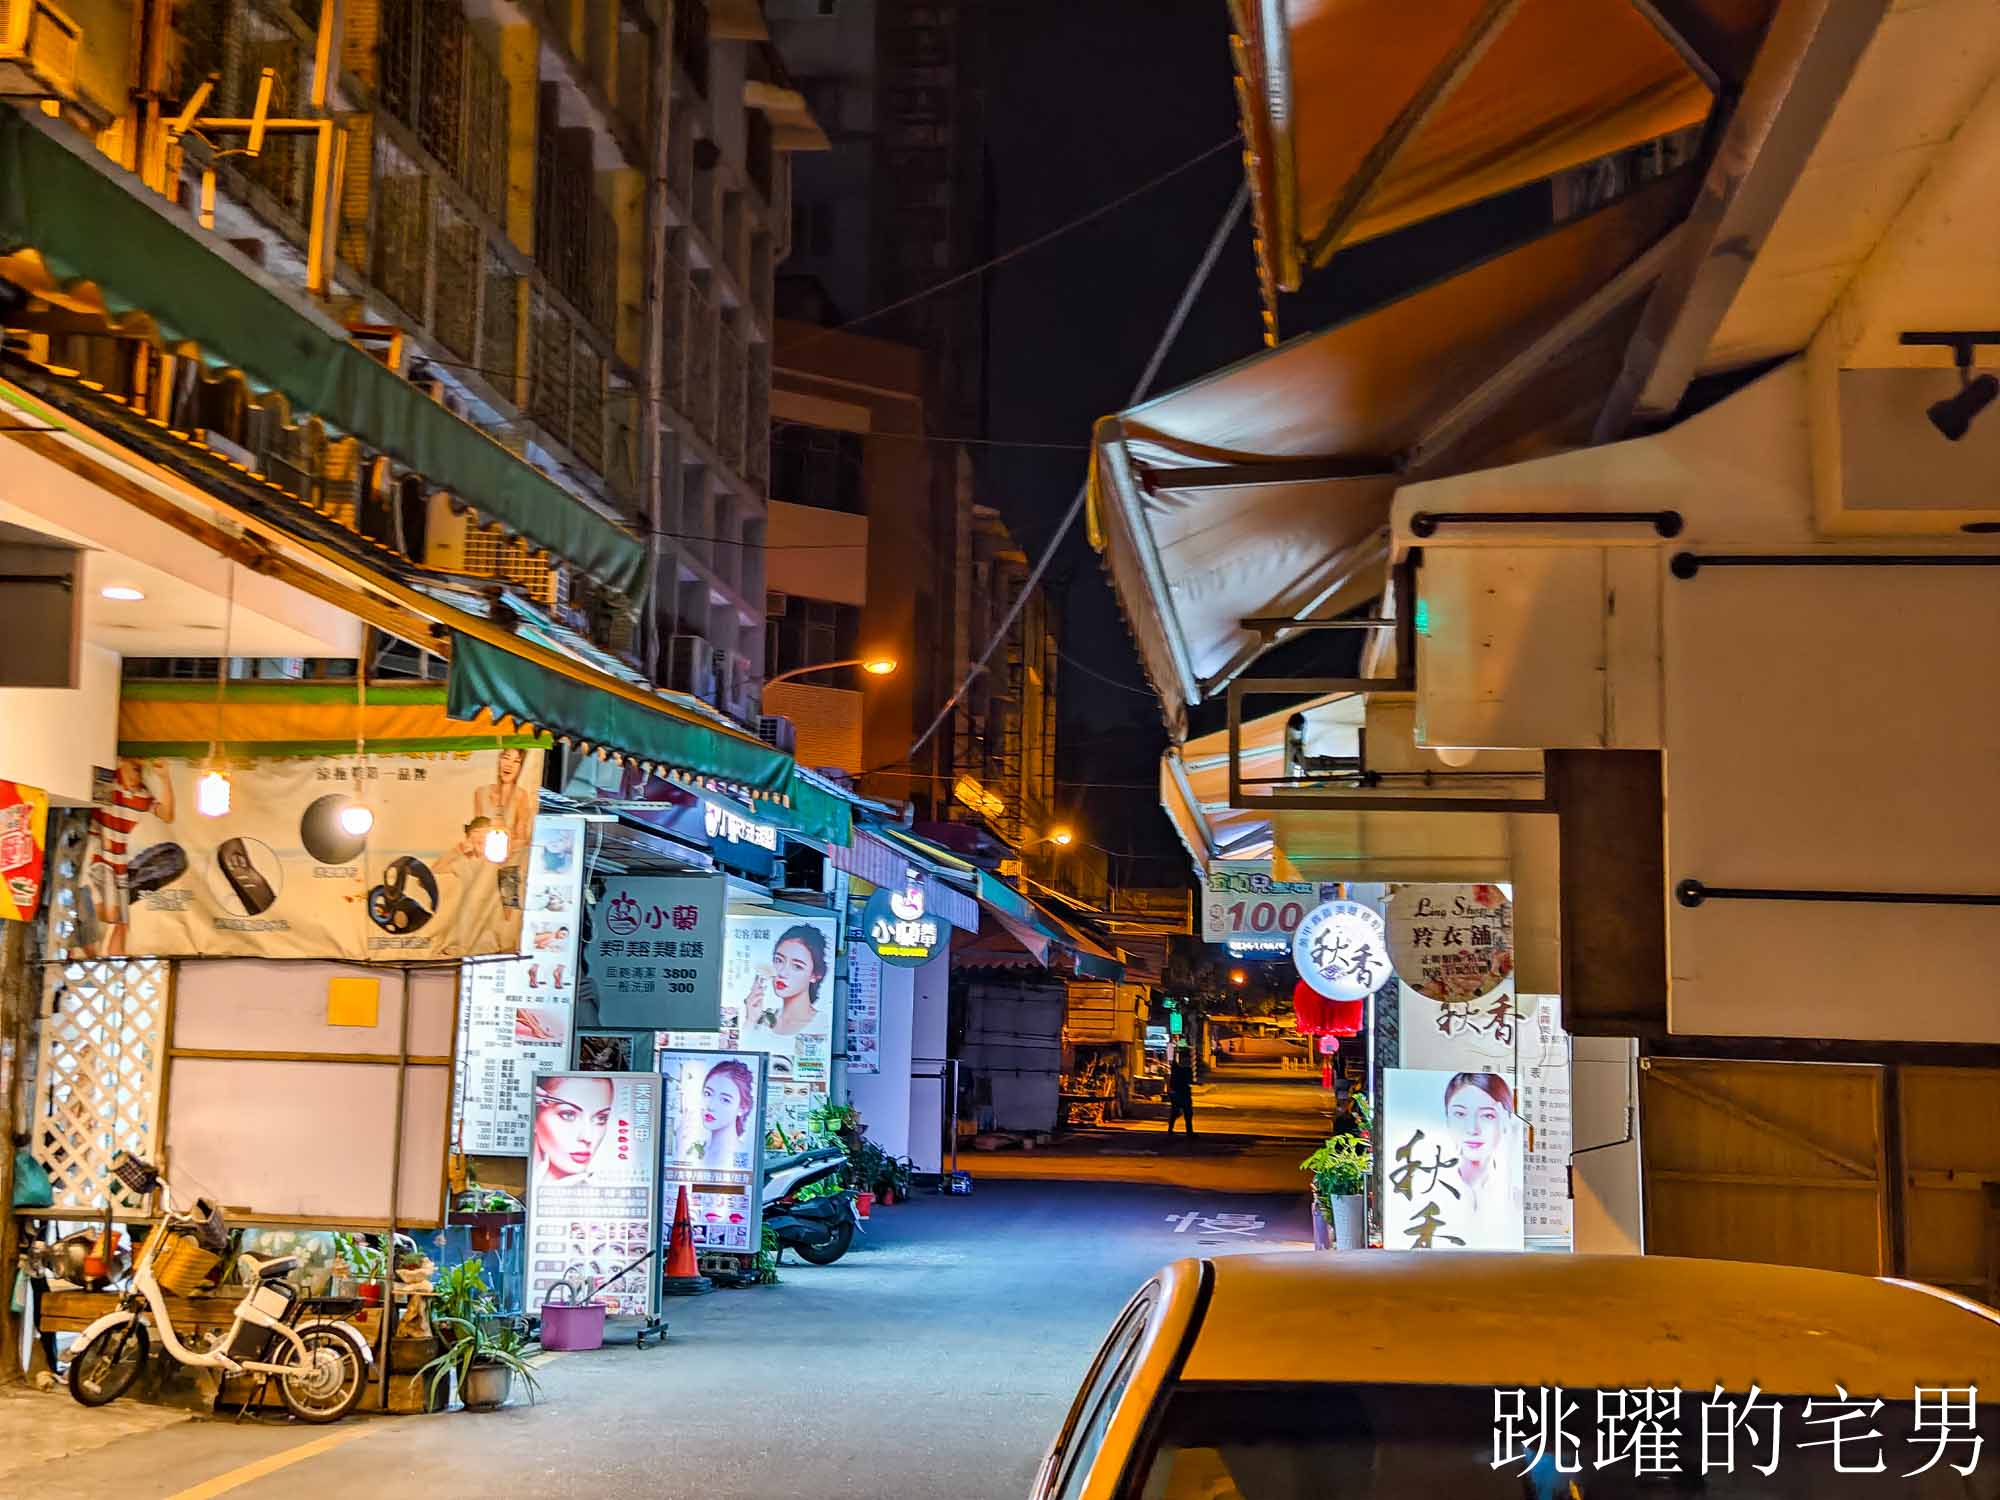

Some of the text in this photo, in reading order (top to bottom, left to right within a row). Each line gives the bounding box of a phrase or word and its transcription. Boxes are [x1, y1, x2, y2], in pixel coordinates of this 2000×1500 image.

[645, 905, 699, 931] 小蘭
[1227, 901, 1304, 932] 100
[1310, 928, 1384, 988] 秋香
[668, 982, 695, 993] 300
[1164, 1211, 1266, 1236] 慢
